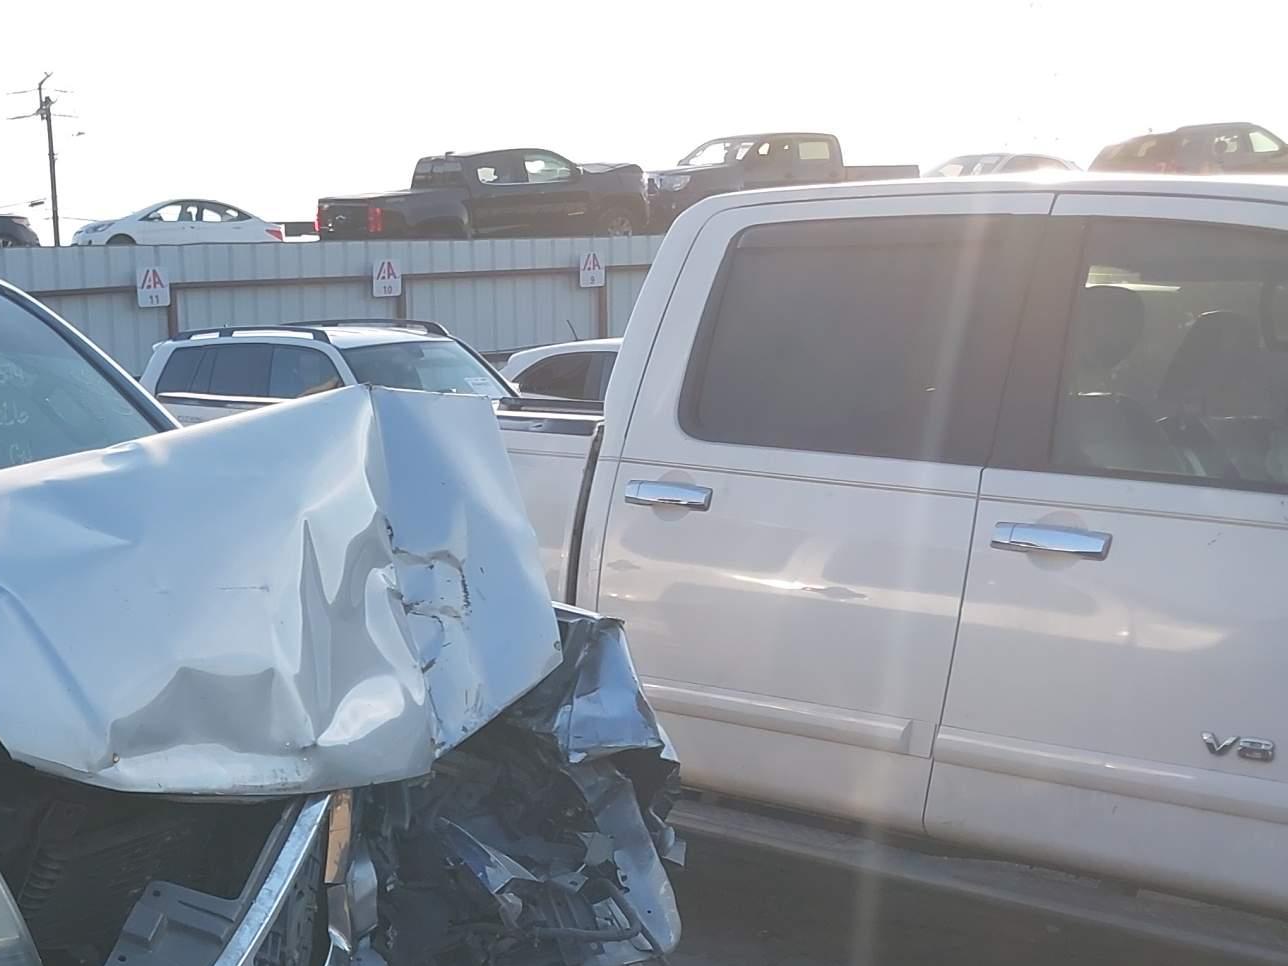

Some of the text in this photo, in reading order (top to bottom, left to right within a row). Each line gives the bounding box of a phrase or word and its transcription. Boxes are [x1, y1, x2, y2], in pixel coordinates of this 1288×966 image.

[383, 285, 393, 295] 10
[149, 295, 160, 305] 11
[1200, 731, 1275, 762] V8
